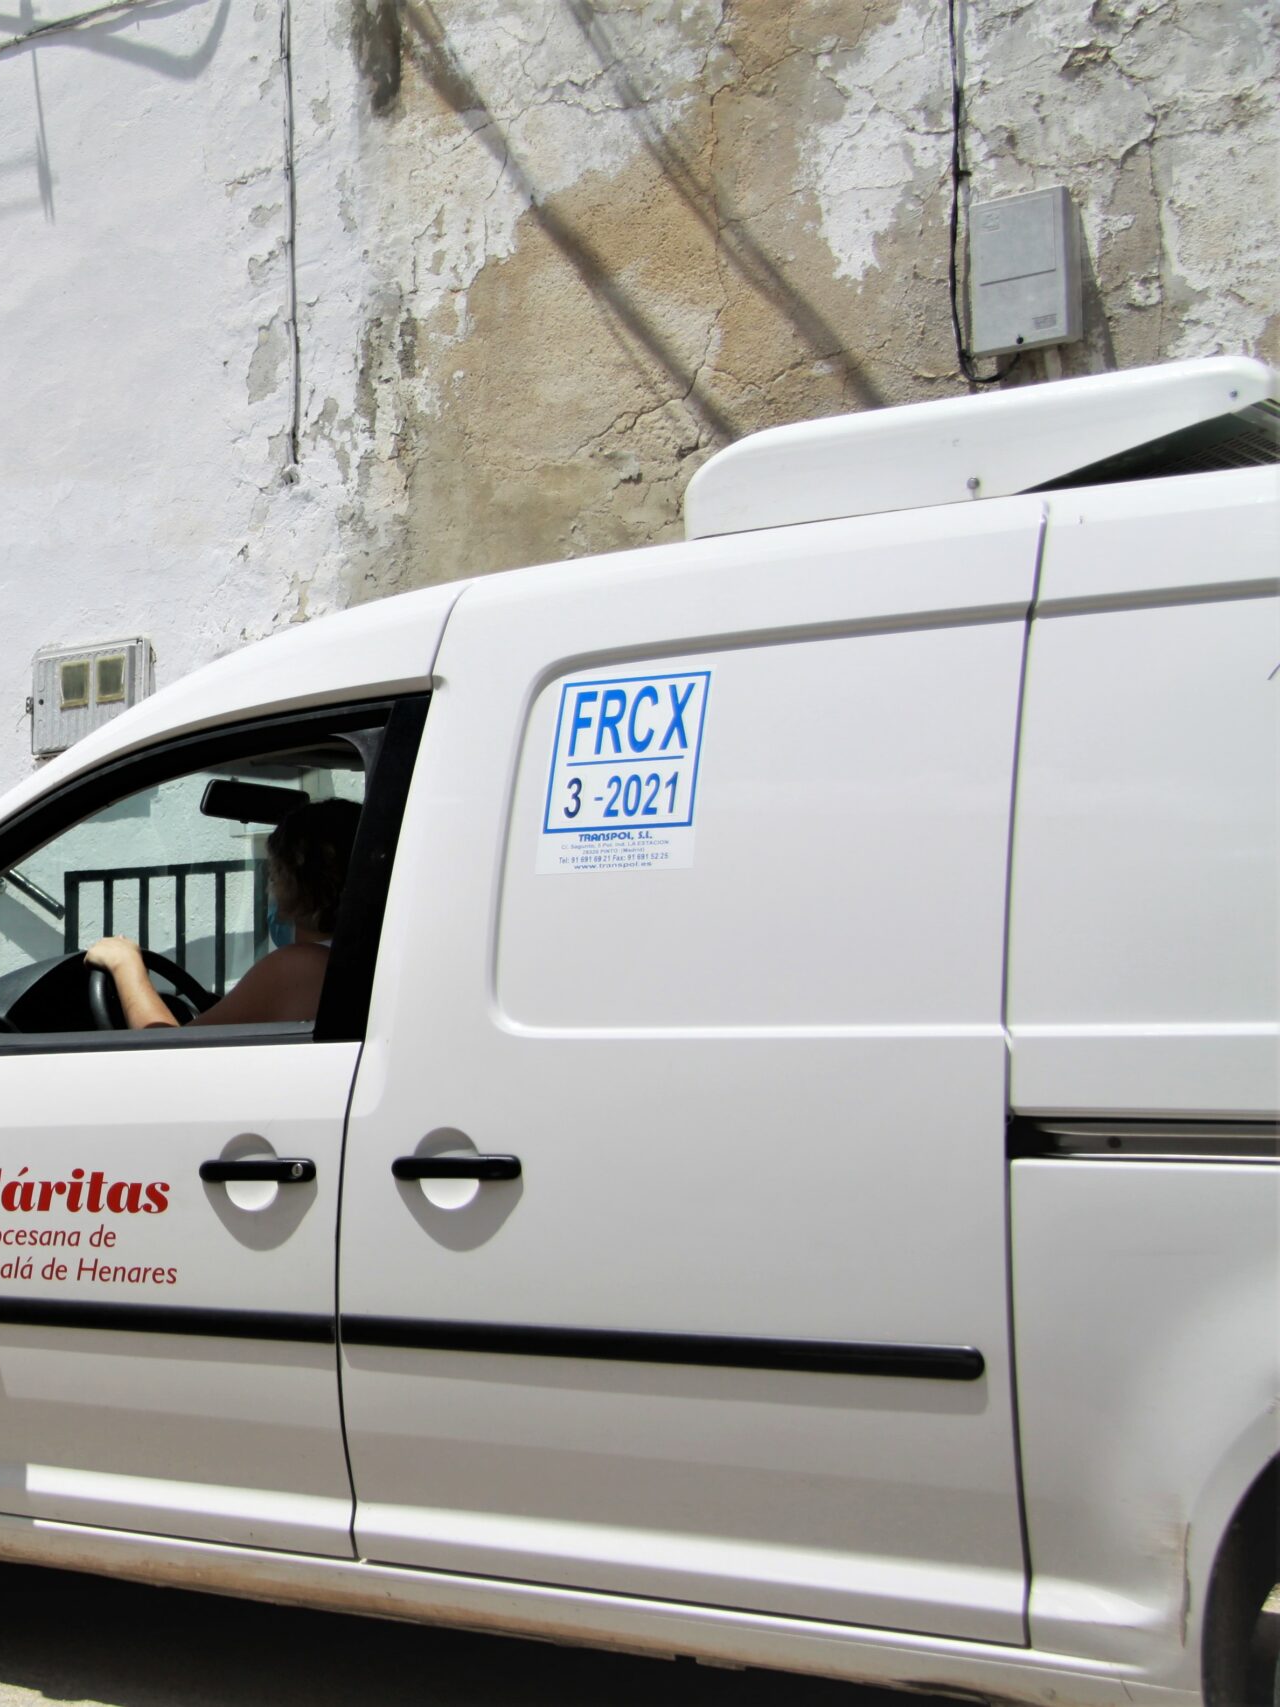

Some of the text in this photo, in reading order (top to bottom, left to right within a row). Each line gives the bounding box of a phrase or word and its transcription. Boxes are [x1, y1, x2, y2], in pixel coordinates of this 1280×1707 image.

[567, 682, 696, 757] FRCX
[563, 777, 582, 819] 3
[578, 831, 653, 842] TRANSPOL, S.L.
[559, 856, 570, 864] Tel:
[89, 1224, 116, 1247] de
[41, 1257, 68, 1280] de
[77, 1258, 177, 1284] Henares
